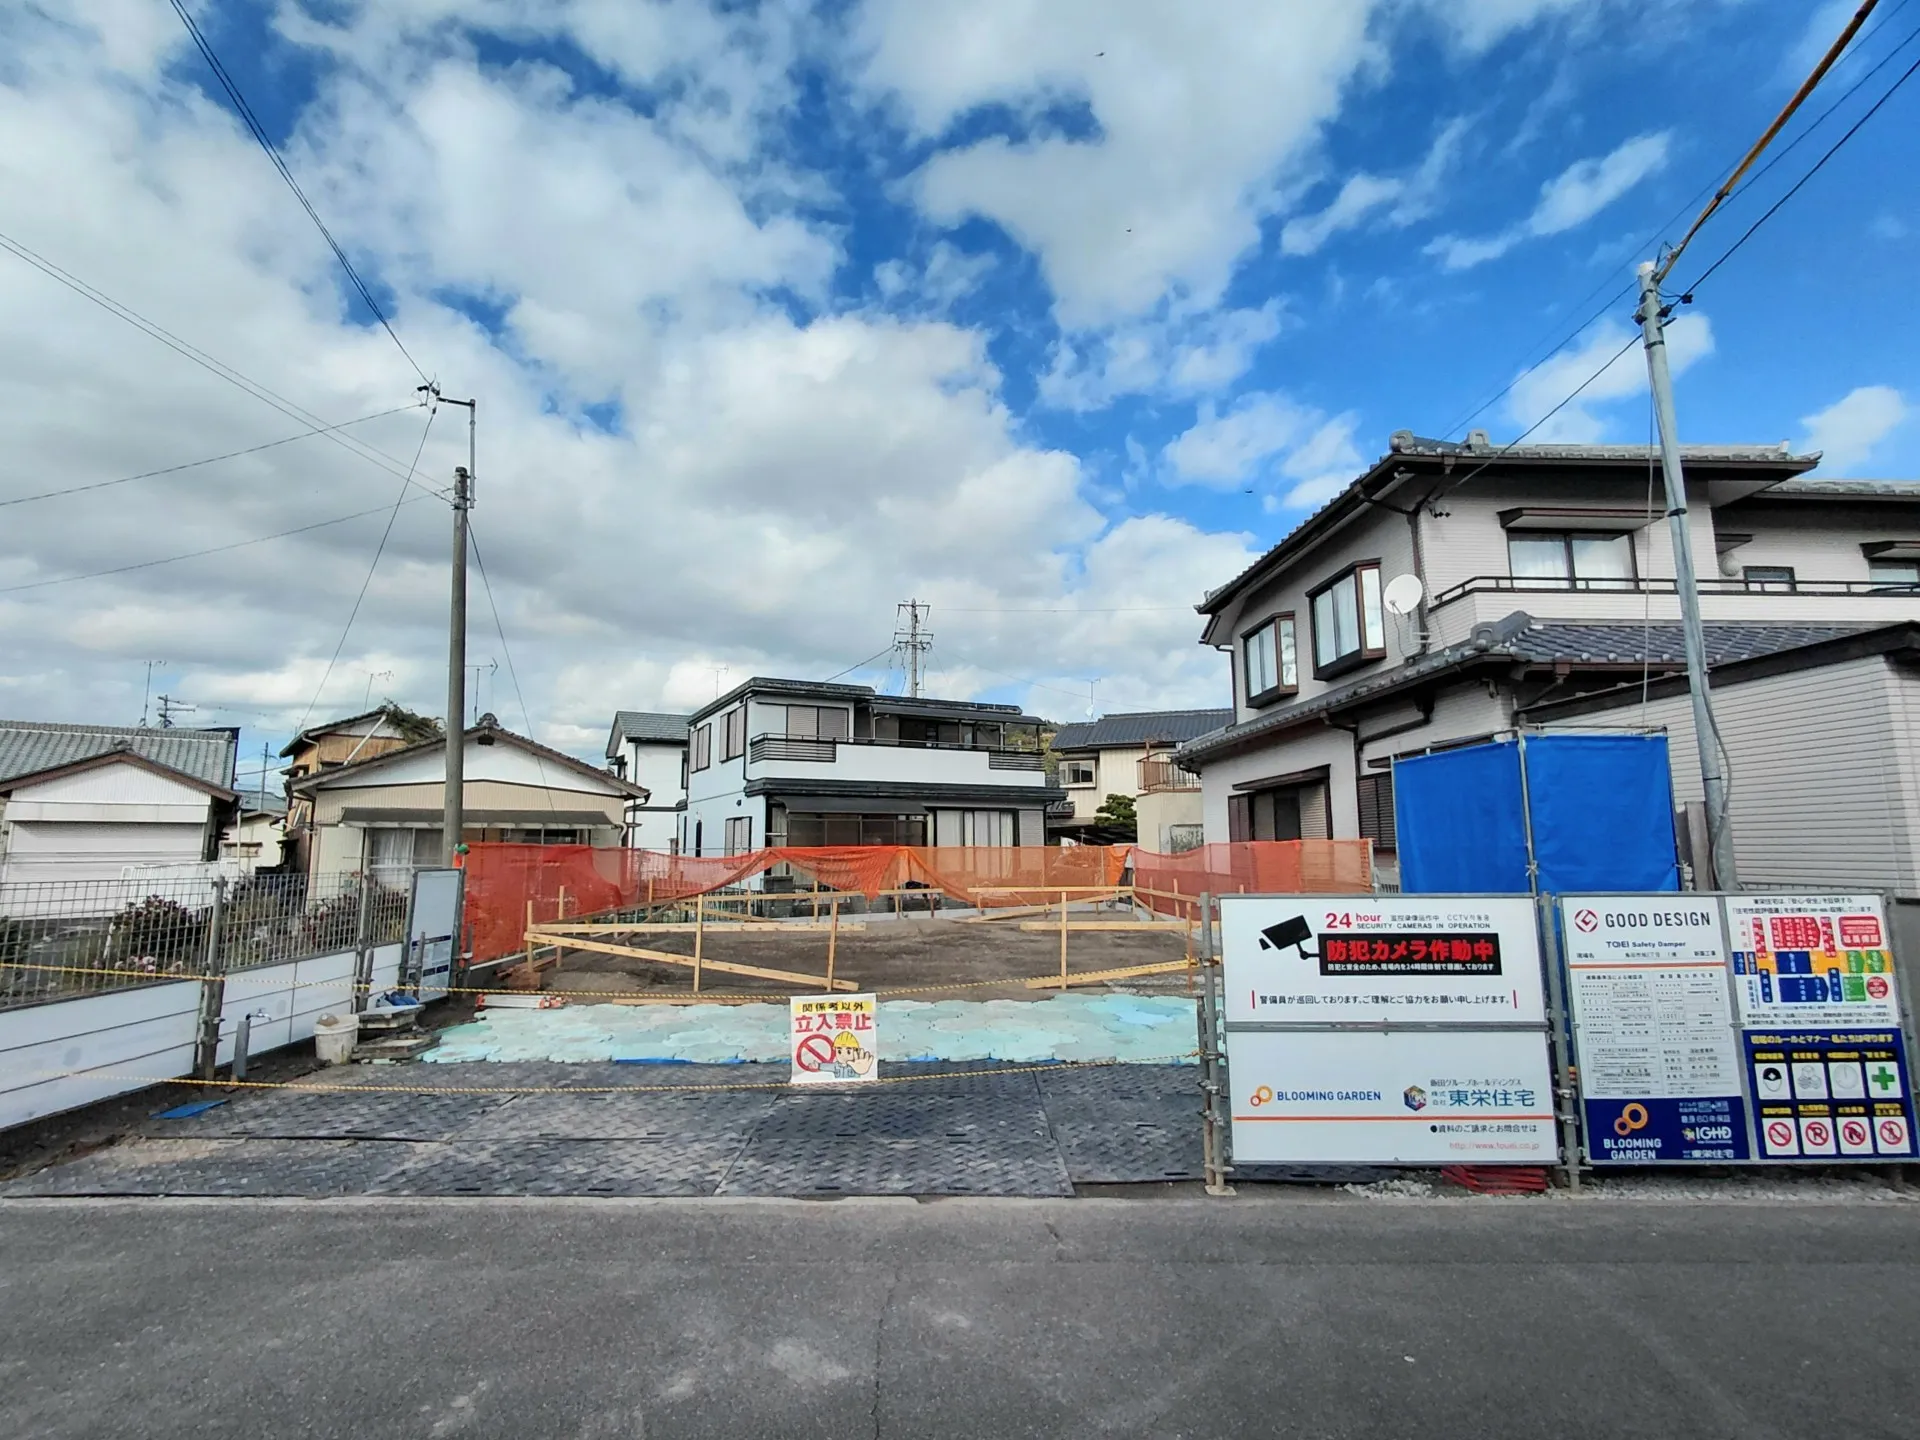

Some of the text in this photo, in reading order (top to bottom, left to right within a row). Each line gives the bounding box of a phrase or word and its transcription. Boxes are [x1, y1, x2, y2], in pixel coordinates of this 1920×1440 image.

[1325, 913, 1382, 929] 24 hour
[1605, 911, 1711, 928] GOOD DESIGN
[1356, 922, 1393, 930] SECURITY
[1396, 922, 1433, 930] CAMERAS
[1447, 922, 1491, 930] OPERATION
[1657, 940, 1687, 948] Damper
[1326, 939, 1494, 961] 防犯カメラ作動中
[795, 1013, 872, 1033] 立入禁止
[1430, 1078, 1523, 1087] 飯田グループホールディングス
[1277, 1091, 1381, 1101] BLOOMING GARDEN
[1448, 1089, 1535, 1107] 東栄住宅
[1603, 1138, 1662, 1149] BLOOMING
[1611, 1149, 1656, 1160] GARDEN
